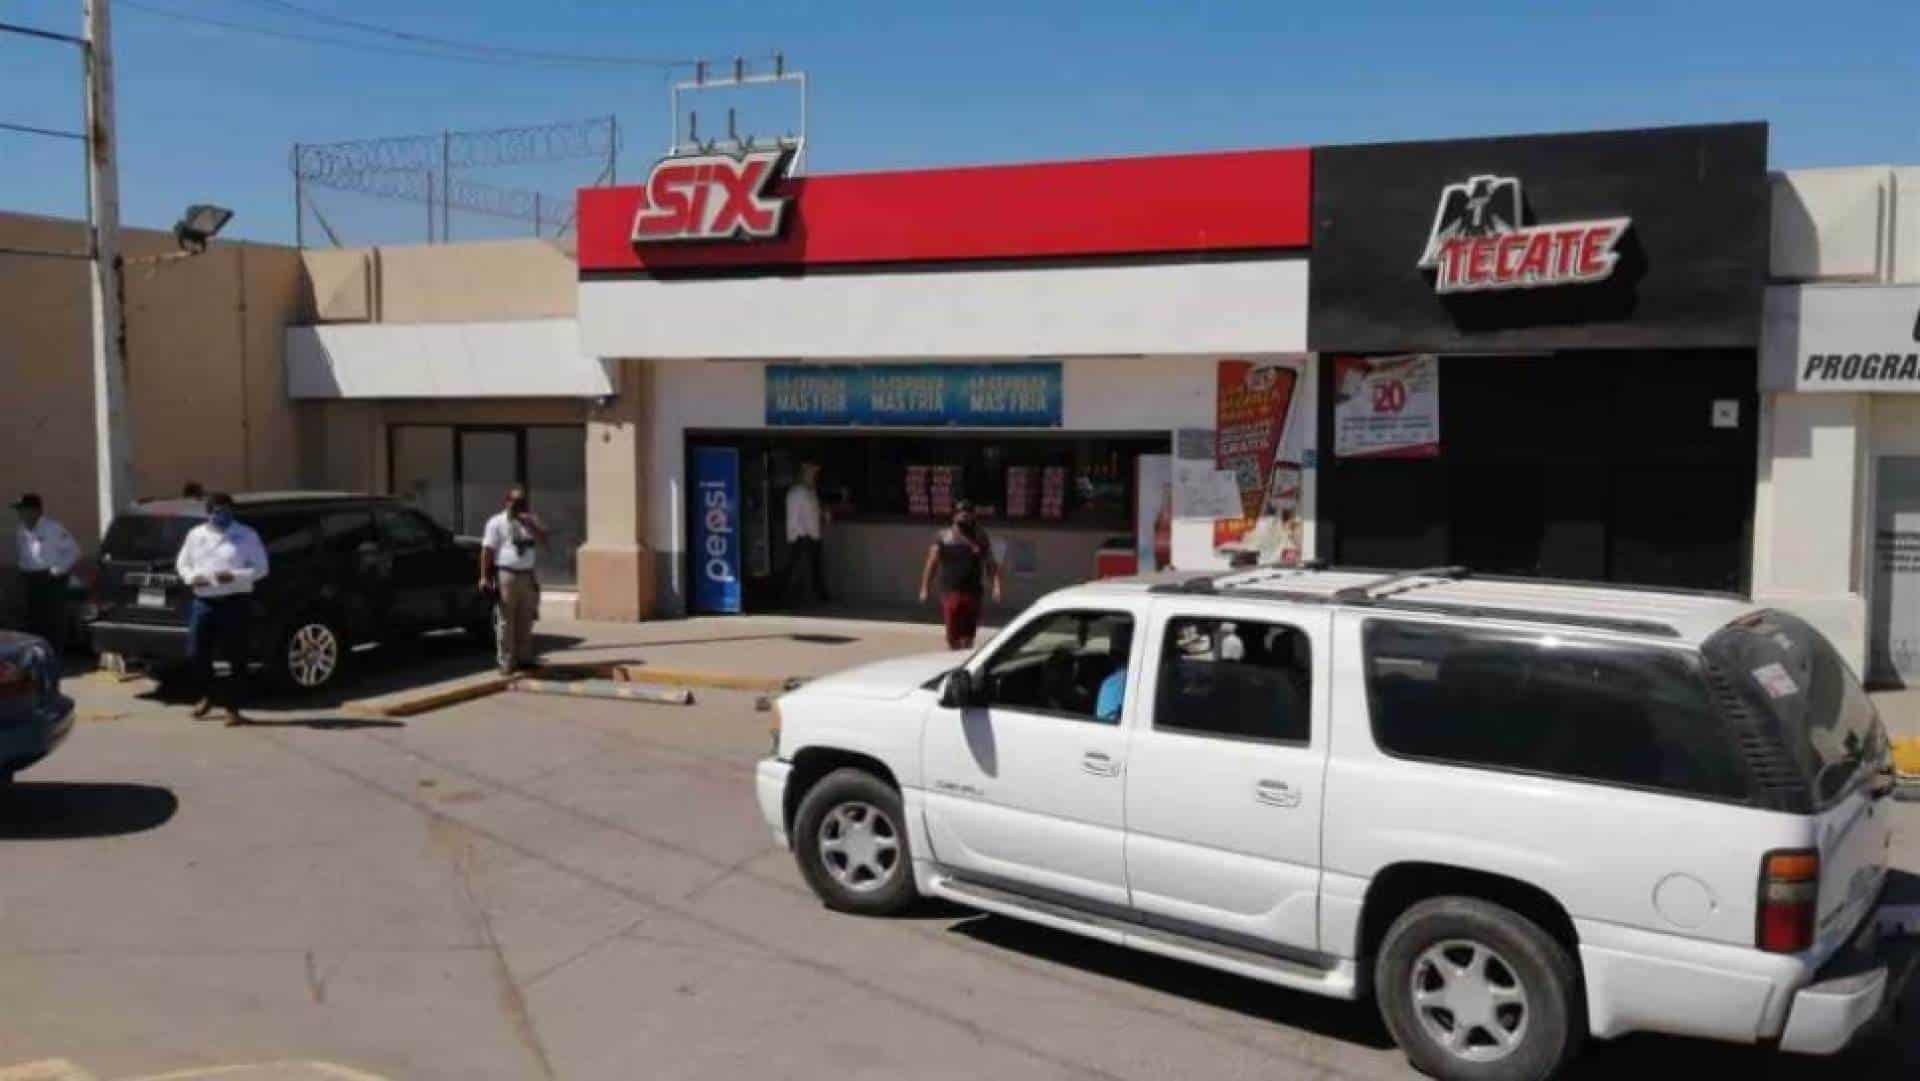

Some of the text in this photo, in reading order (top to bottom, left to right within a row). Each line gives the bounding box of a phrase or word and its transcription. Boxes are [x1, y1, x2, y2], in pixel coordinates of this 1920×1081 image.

[1438, 226, 1614, 284] TECATE
[1803, 353, 1920, 381] PROGRA
[699, 480, 736, 583] pepsi
